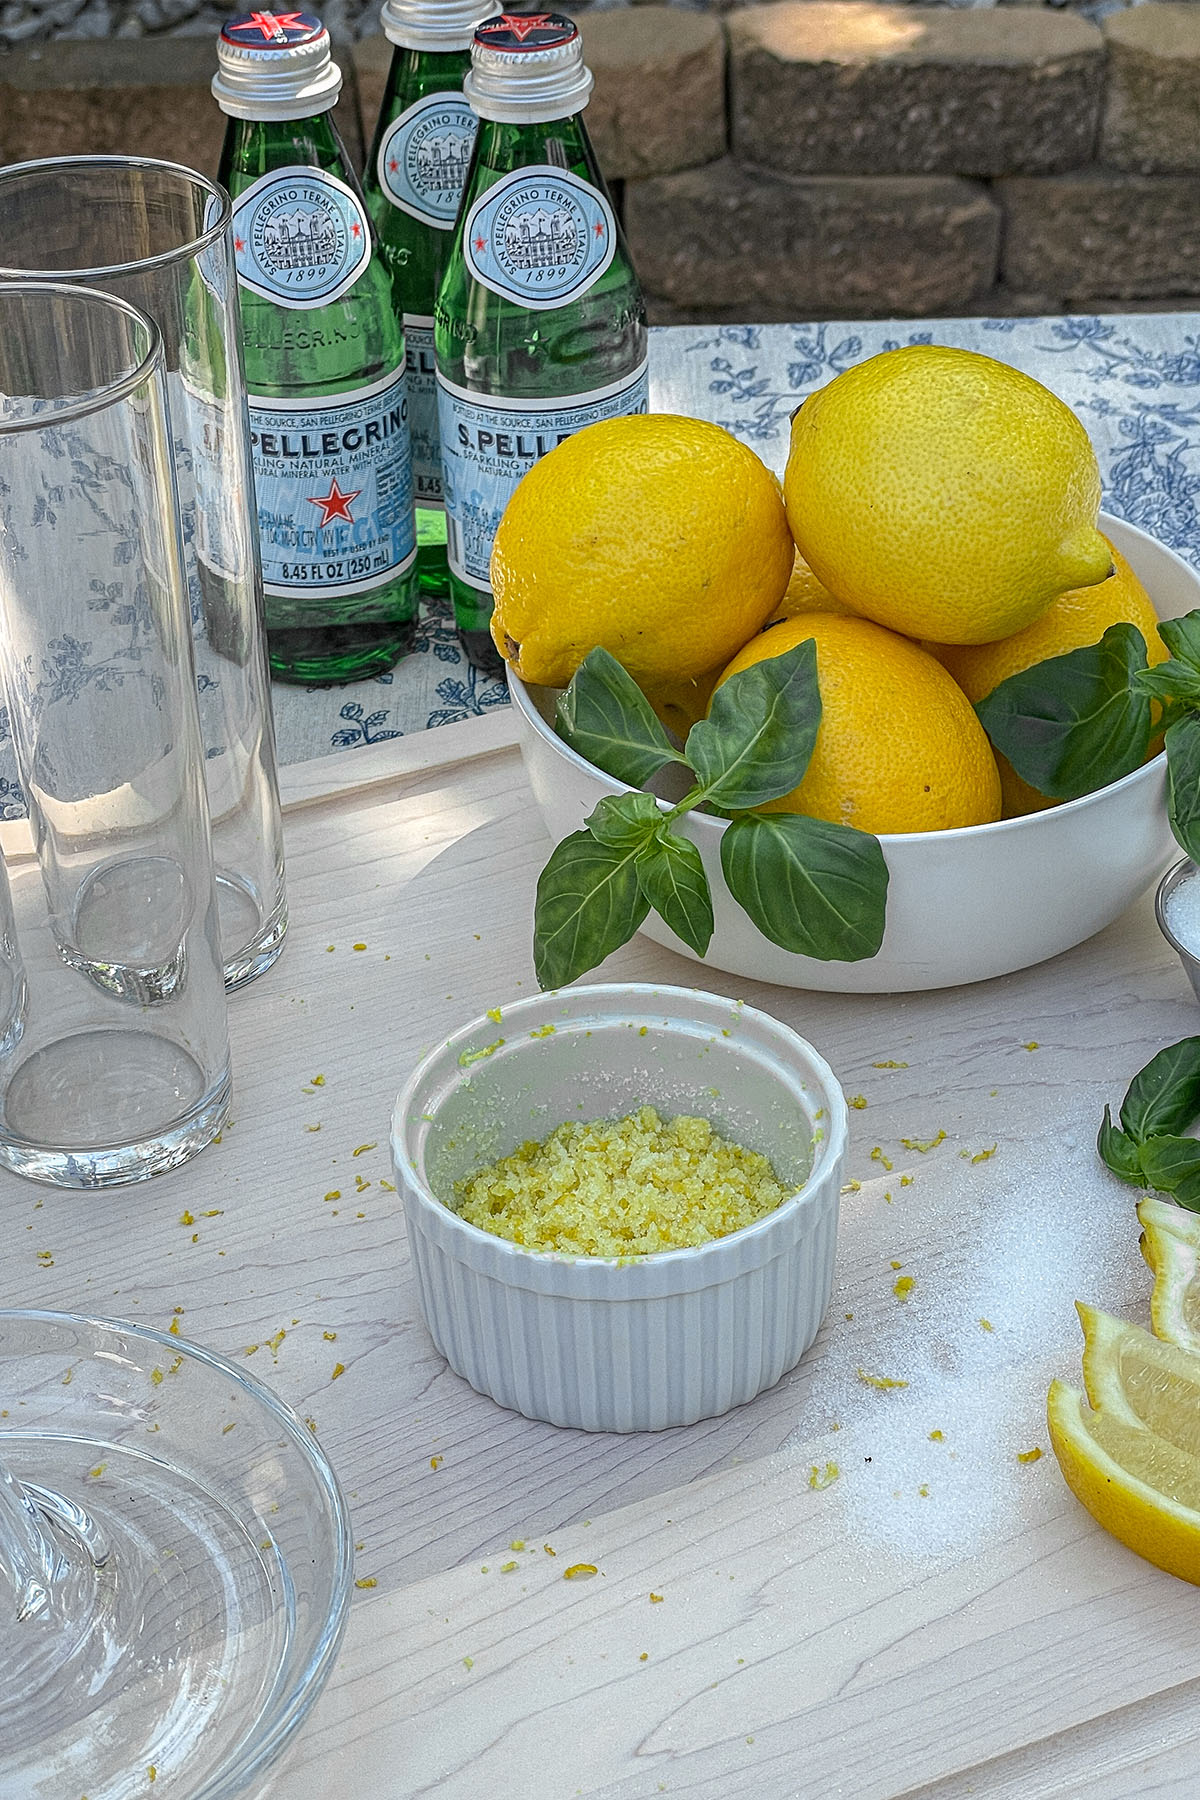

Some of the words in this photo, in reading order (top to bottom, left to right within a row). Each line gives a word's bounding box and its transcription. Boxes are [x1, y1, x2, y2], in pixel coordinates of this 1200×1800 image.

[409, 115, 450, 168] PELLEGRINO
[411, 174, 428, 196] SAN
[303, 190, 336, 214] TERME
[545, 189, 578, 214] TERME
[254, 190, 298, 247] PELLEGRINO
[495, 189, 540, 246] PELLEGRINO
[331, 229, 345, 266] ITALIA
[573, 228, 587, 266] ITALIA
[257, 252, 277, 276] SAN
[286, 267, 327, 283] 1899
[498, 252, 517, 275] SAN
[525, 266, 567, 283] 1899
[265, 416, 299, 428] SOURCE,
[301, 417, 318, 428] SAN
[320, 409, 362, 426] PELLEGRINO
[476, 413, 484, 421] AT
[486, 414, 498, 425] THE
[500, 417, 534, 429] SOURCE,
[535, 418, 553, 428] SAN
[555, 410, 599, 426] PELLEGRINO
[600, 402, 619, 416] TERME
[290, 456, 344, 470] NATURAL
[350, 440, 390, 463] MINERAL
[463, 449, 519, 470] SPARKLING
[281, 468, 319, 479] MINERAL
[324, 465, 350, 477] WATER
[352, 458, 372, 471] WITH
[478, 464, 513, 479] NATURAL
[418, 477, 441, 495] 8.45
[350, 543, 367, 553] USED
[282, 563, 307, 580] 8.45
[312, 564, 323, 579] FL
[327, 562, 344, 577] OZ
[347, 558, 371, 578] (250
[373, 550, 389, 569] mL)
